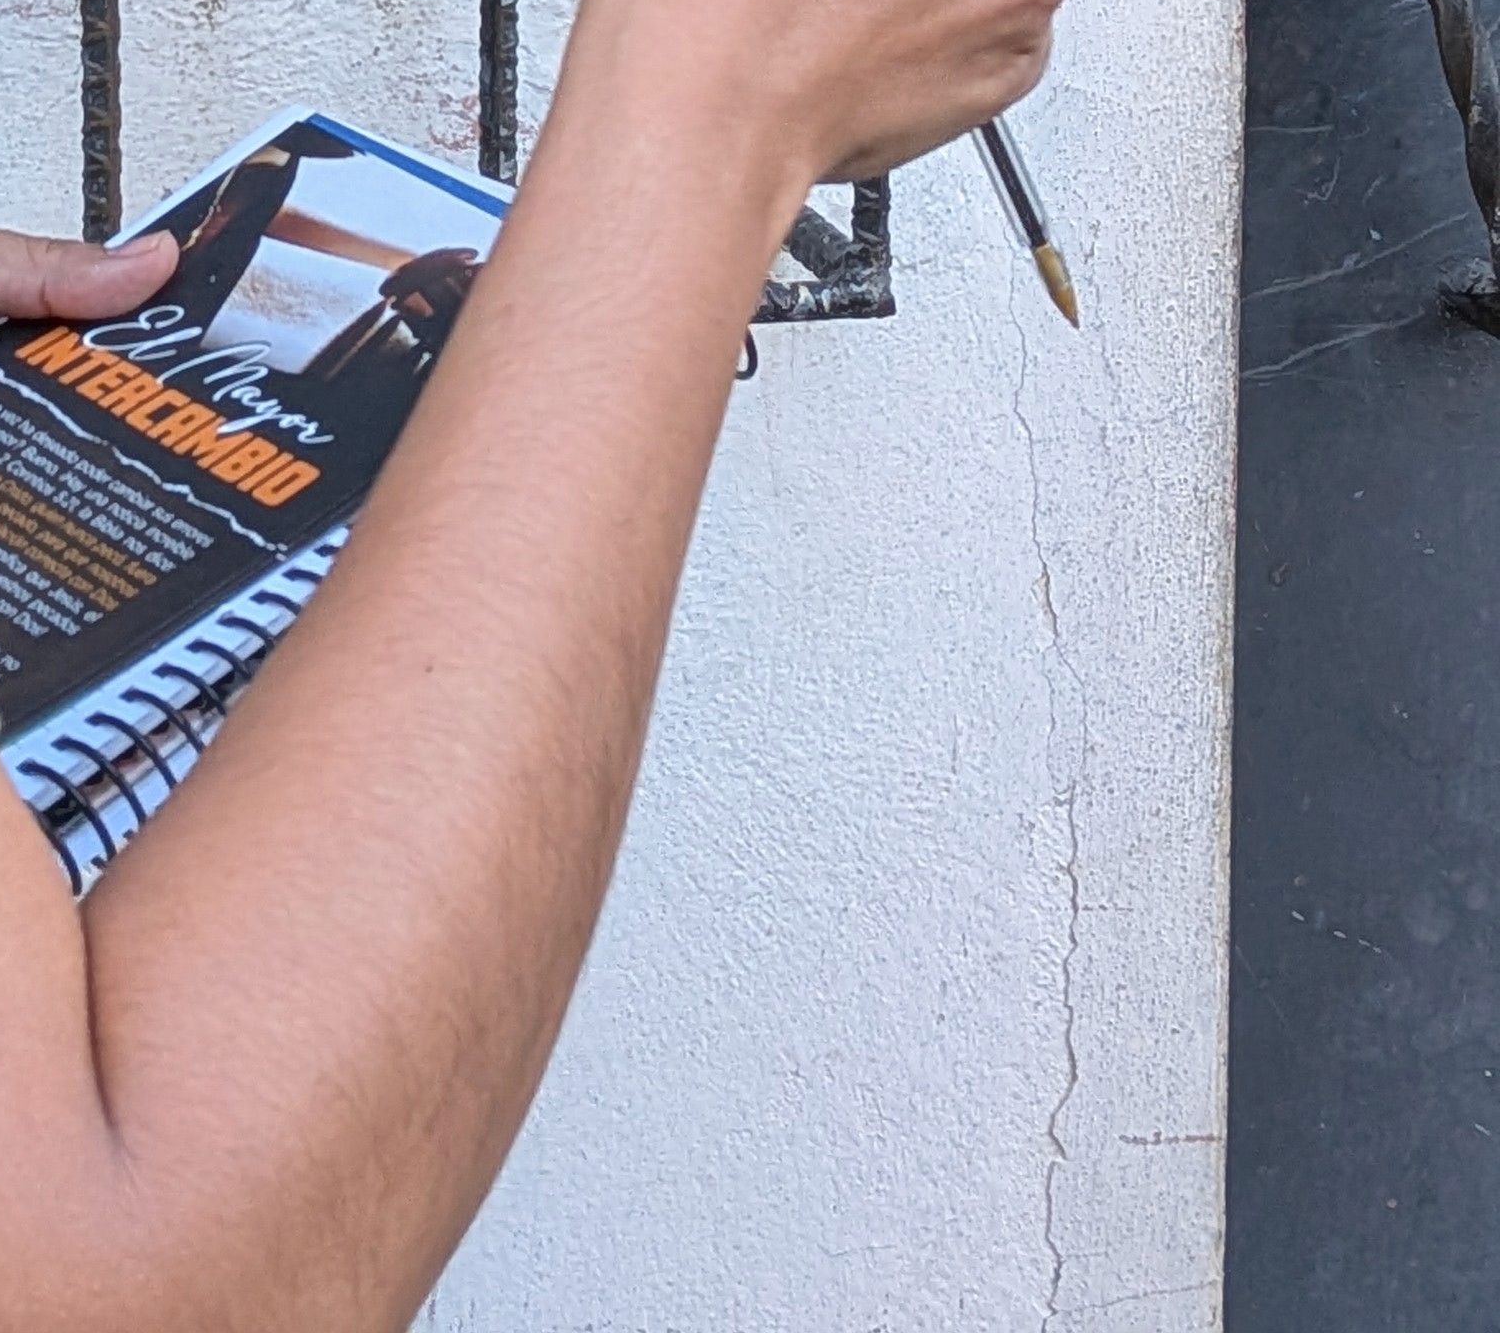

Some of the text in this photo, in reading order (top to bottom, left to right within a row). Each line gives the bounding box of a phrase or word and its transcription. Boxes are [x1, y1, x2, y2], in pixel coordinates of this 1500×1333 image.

[14, 326, 320, 507] INTERCAMBIO
[83, 305, 334, 443] El Mayor
